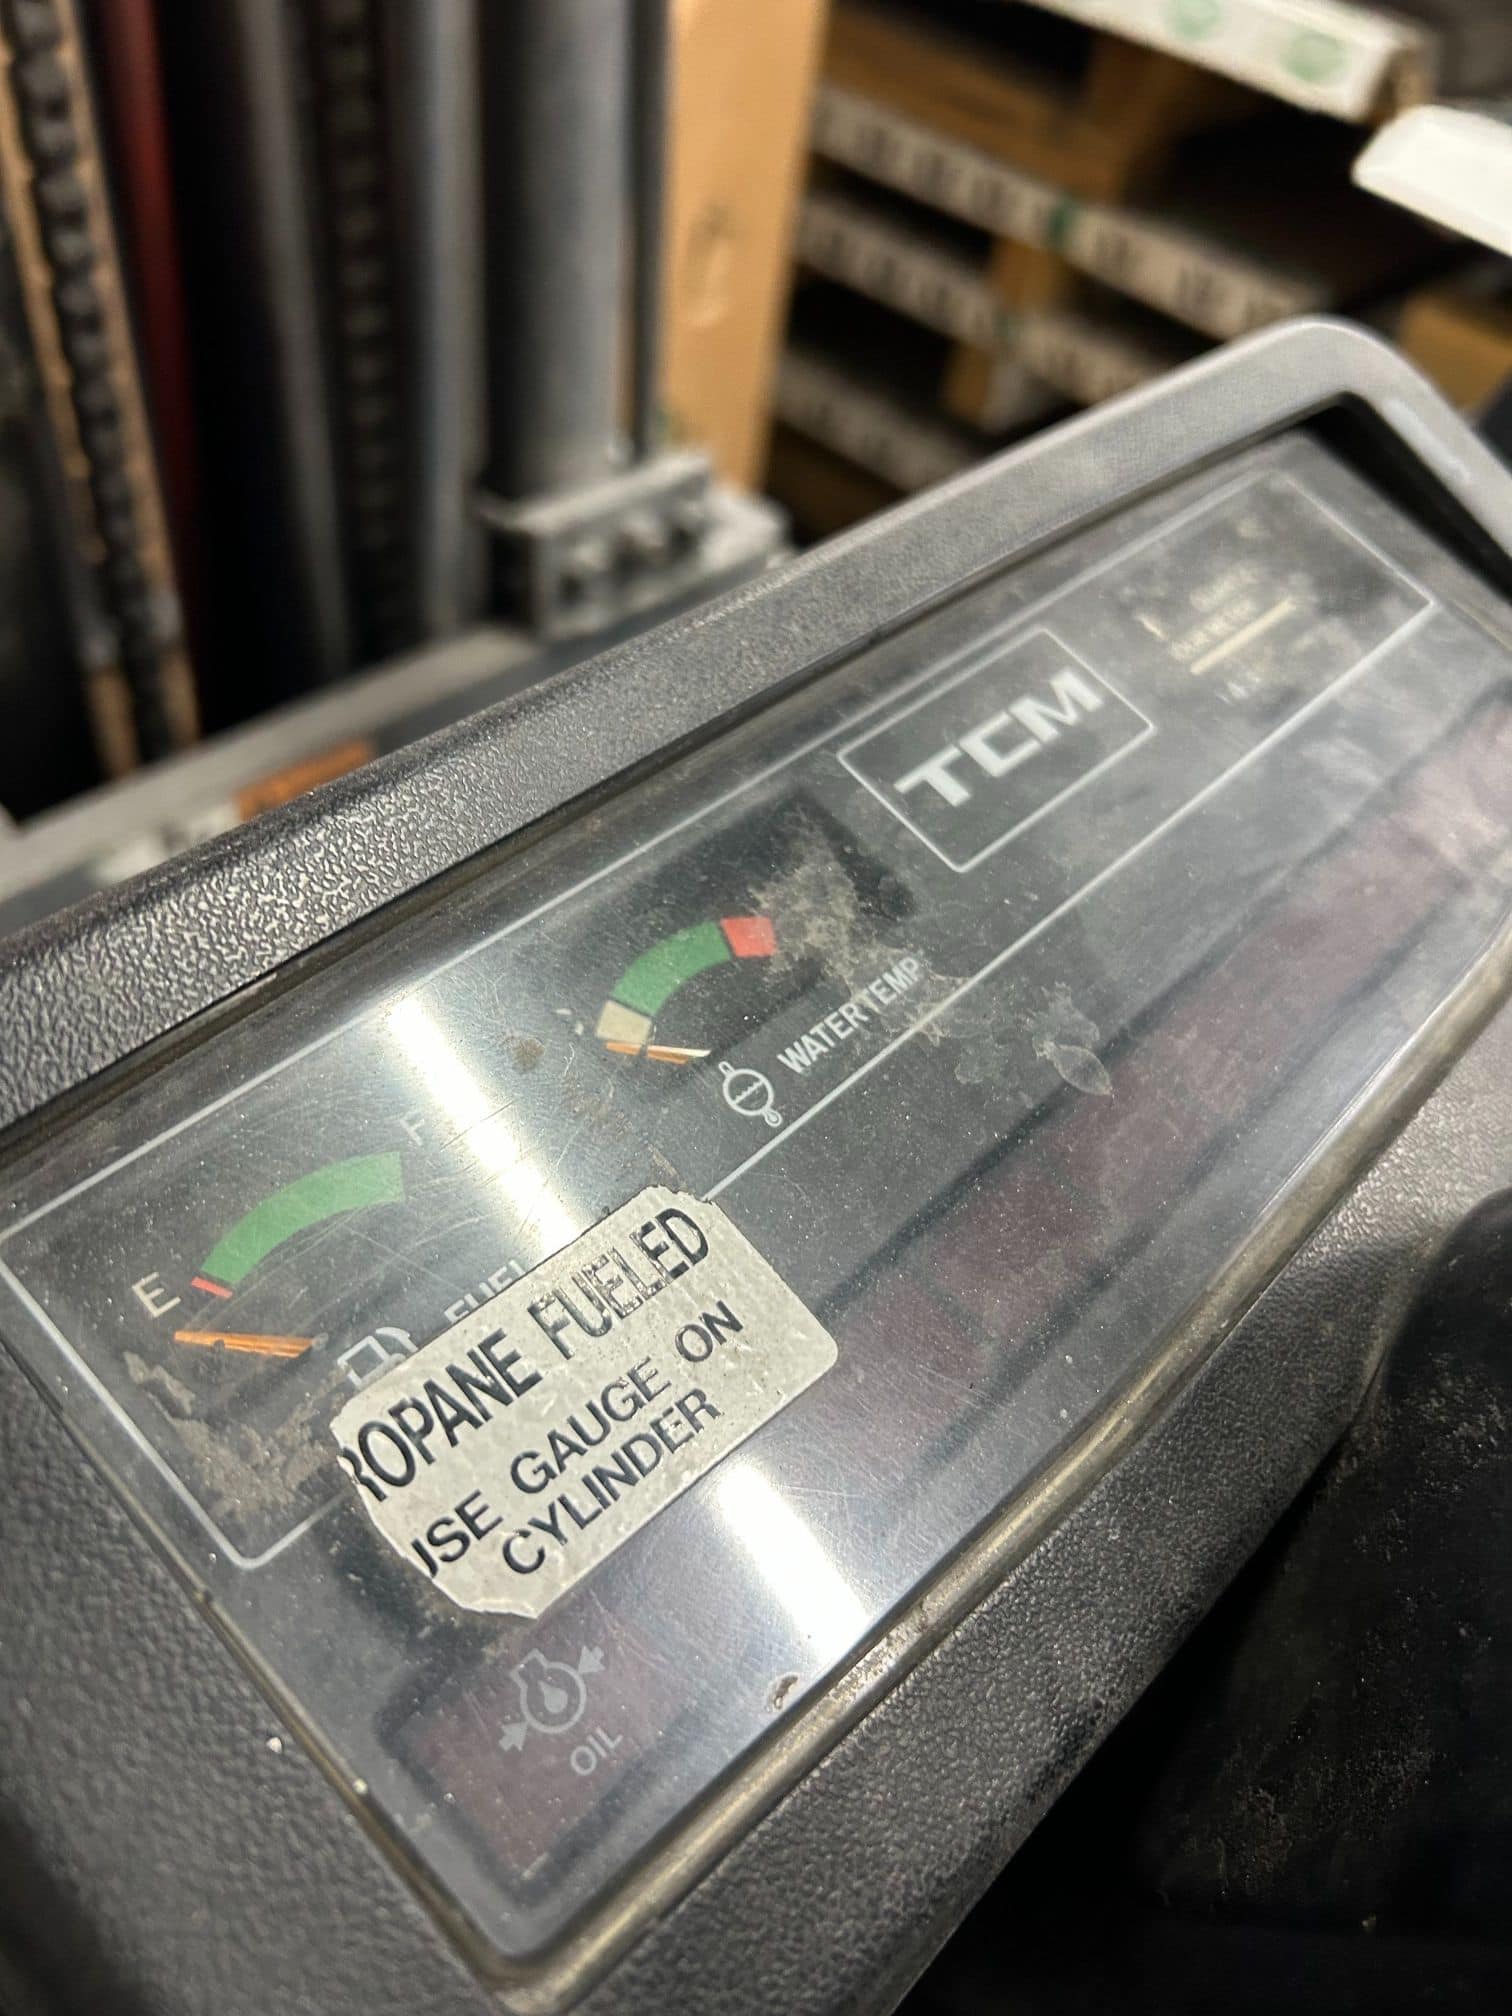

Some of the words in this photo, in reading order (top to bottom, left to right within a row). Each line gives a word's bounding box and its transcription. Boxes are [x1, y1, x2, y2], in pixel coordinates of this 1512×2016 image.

[895, 670, 1105, 807] TCM
[776, 1002, 870, 1076] WATER
[855, 956, 920, 1016] TEMP
[131, 1271, 182, 1319] E
[527, 1207, 710, 1360] FUELED
[509, 1356, 672, 1494] GAUGE
[674, 1300, 744, 1362] ON
[502, 1387, 721, 1575] CYLINDER
[570, 1727, 624, 1776] OIL
